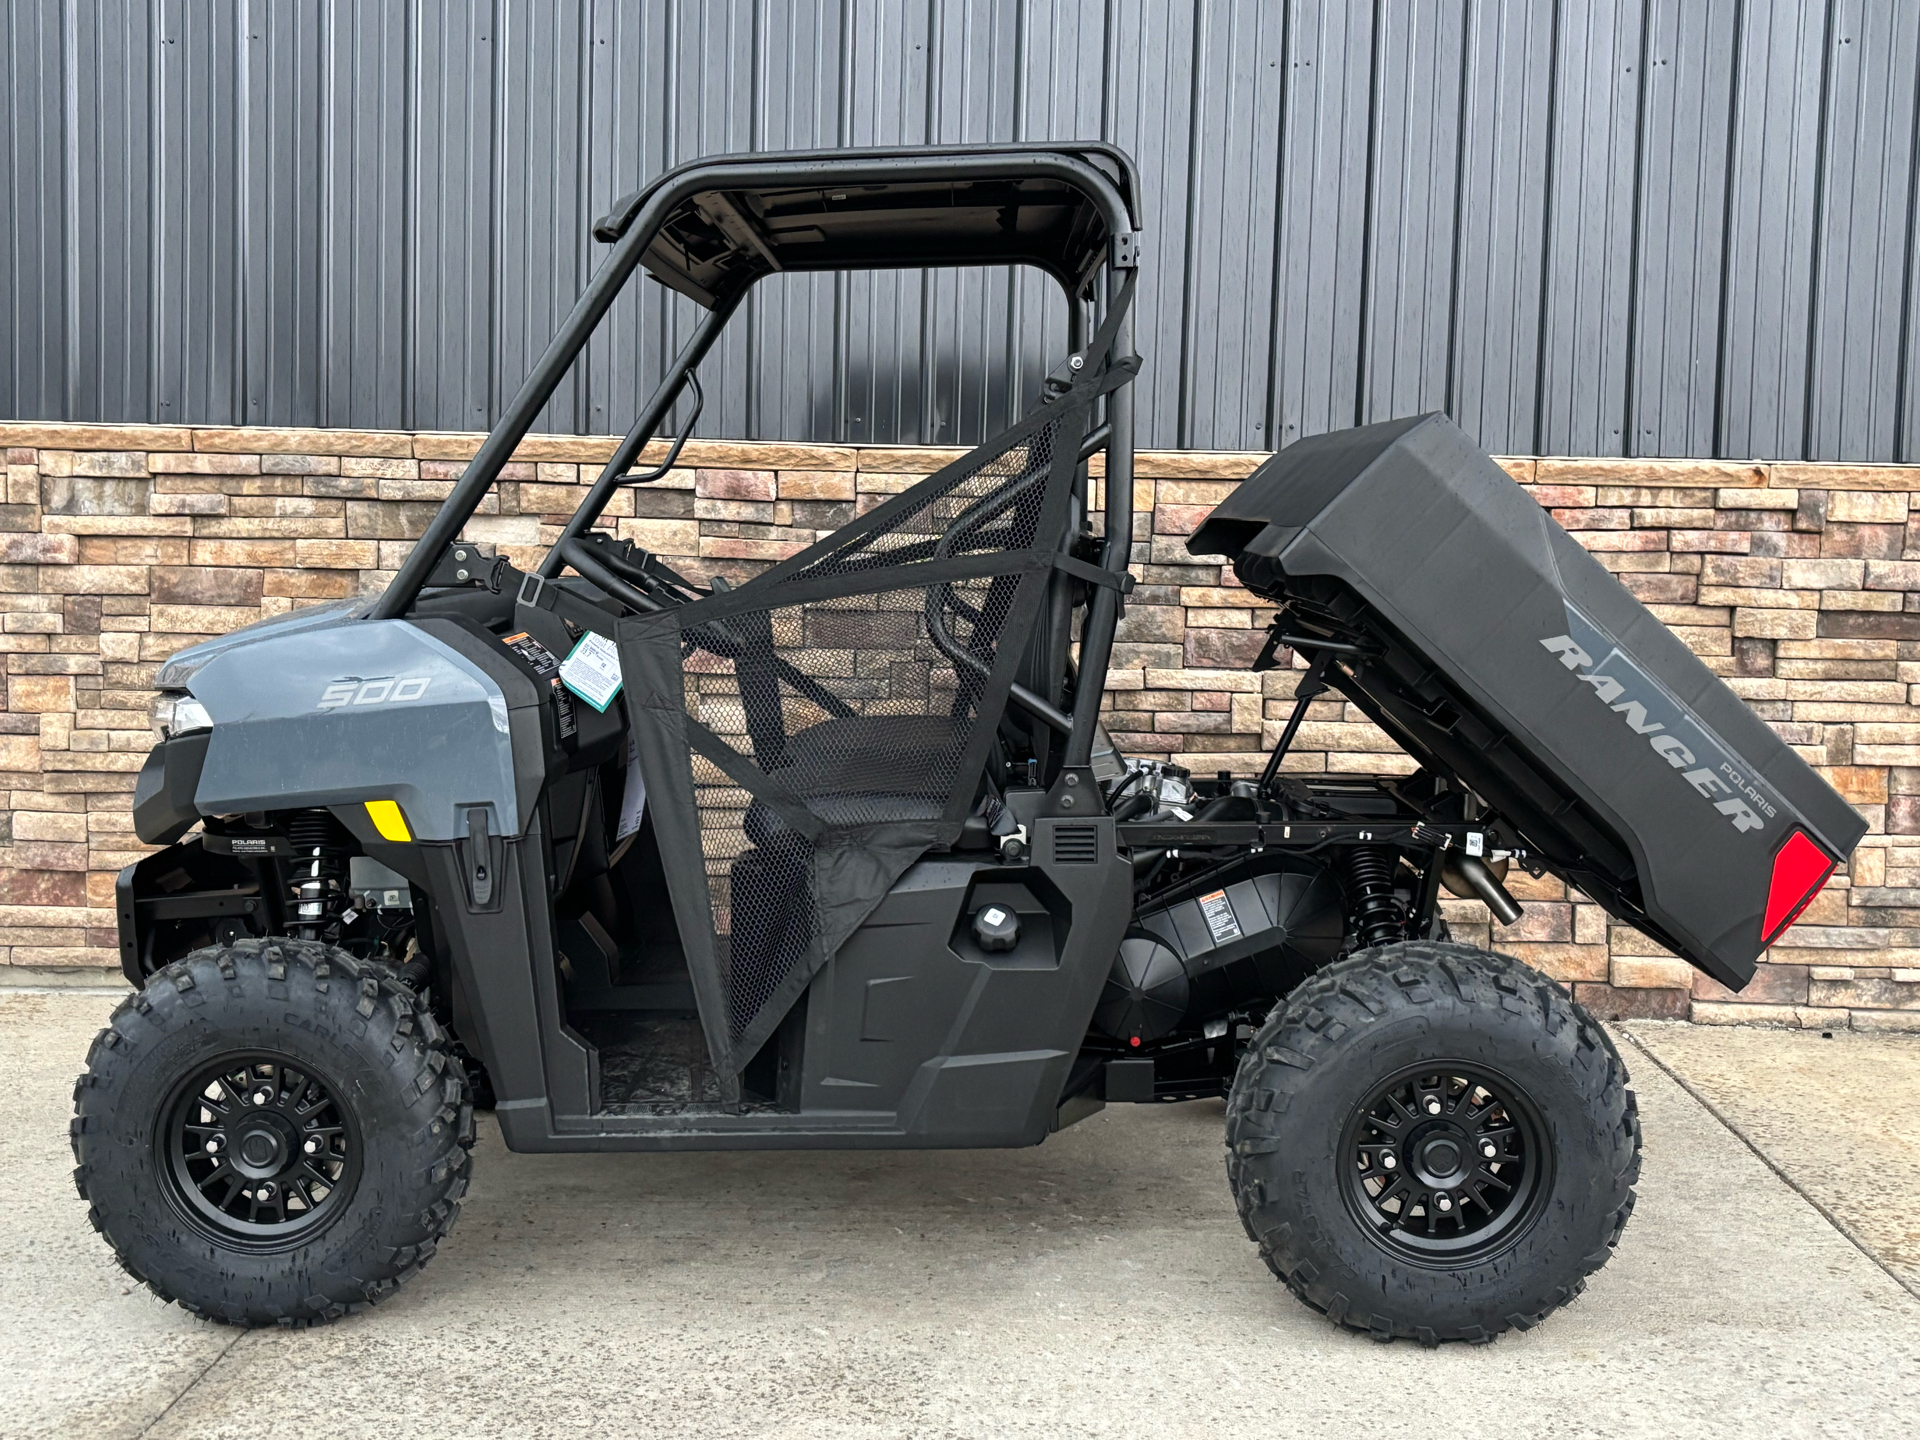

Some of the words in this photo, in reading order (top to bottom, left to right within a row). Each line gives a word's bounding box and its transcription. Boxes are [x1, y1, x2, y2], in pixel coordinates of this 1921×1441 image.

[316, 677, 432, 709] 500
[1539, 634, 1765, 834] RANGER
[1719, 761, 1778, 819] POLARIS
